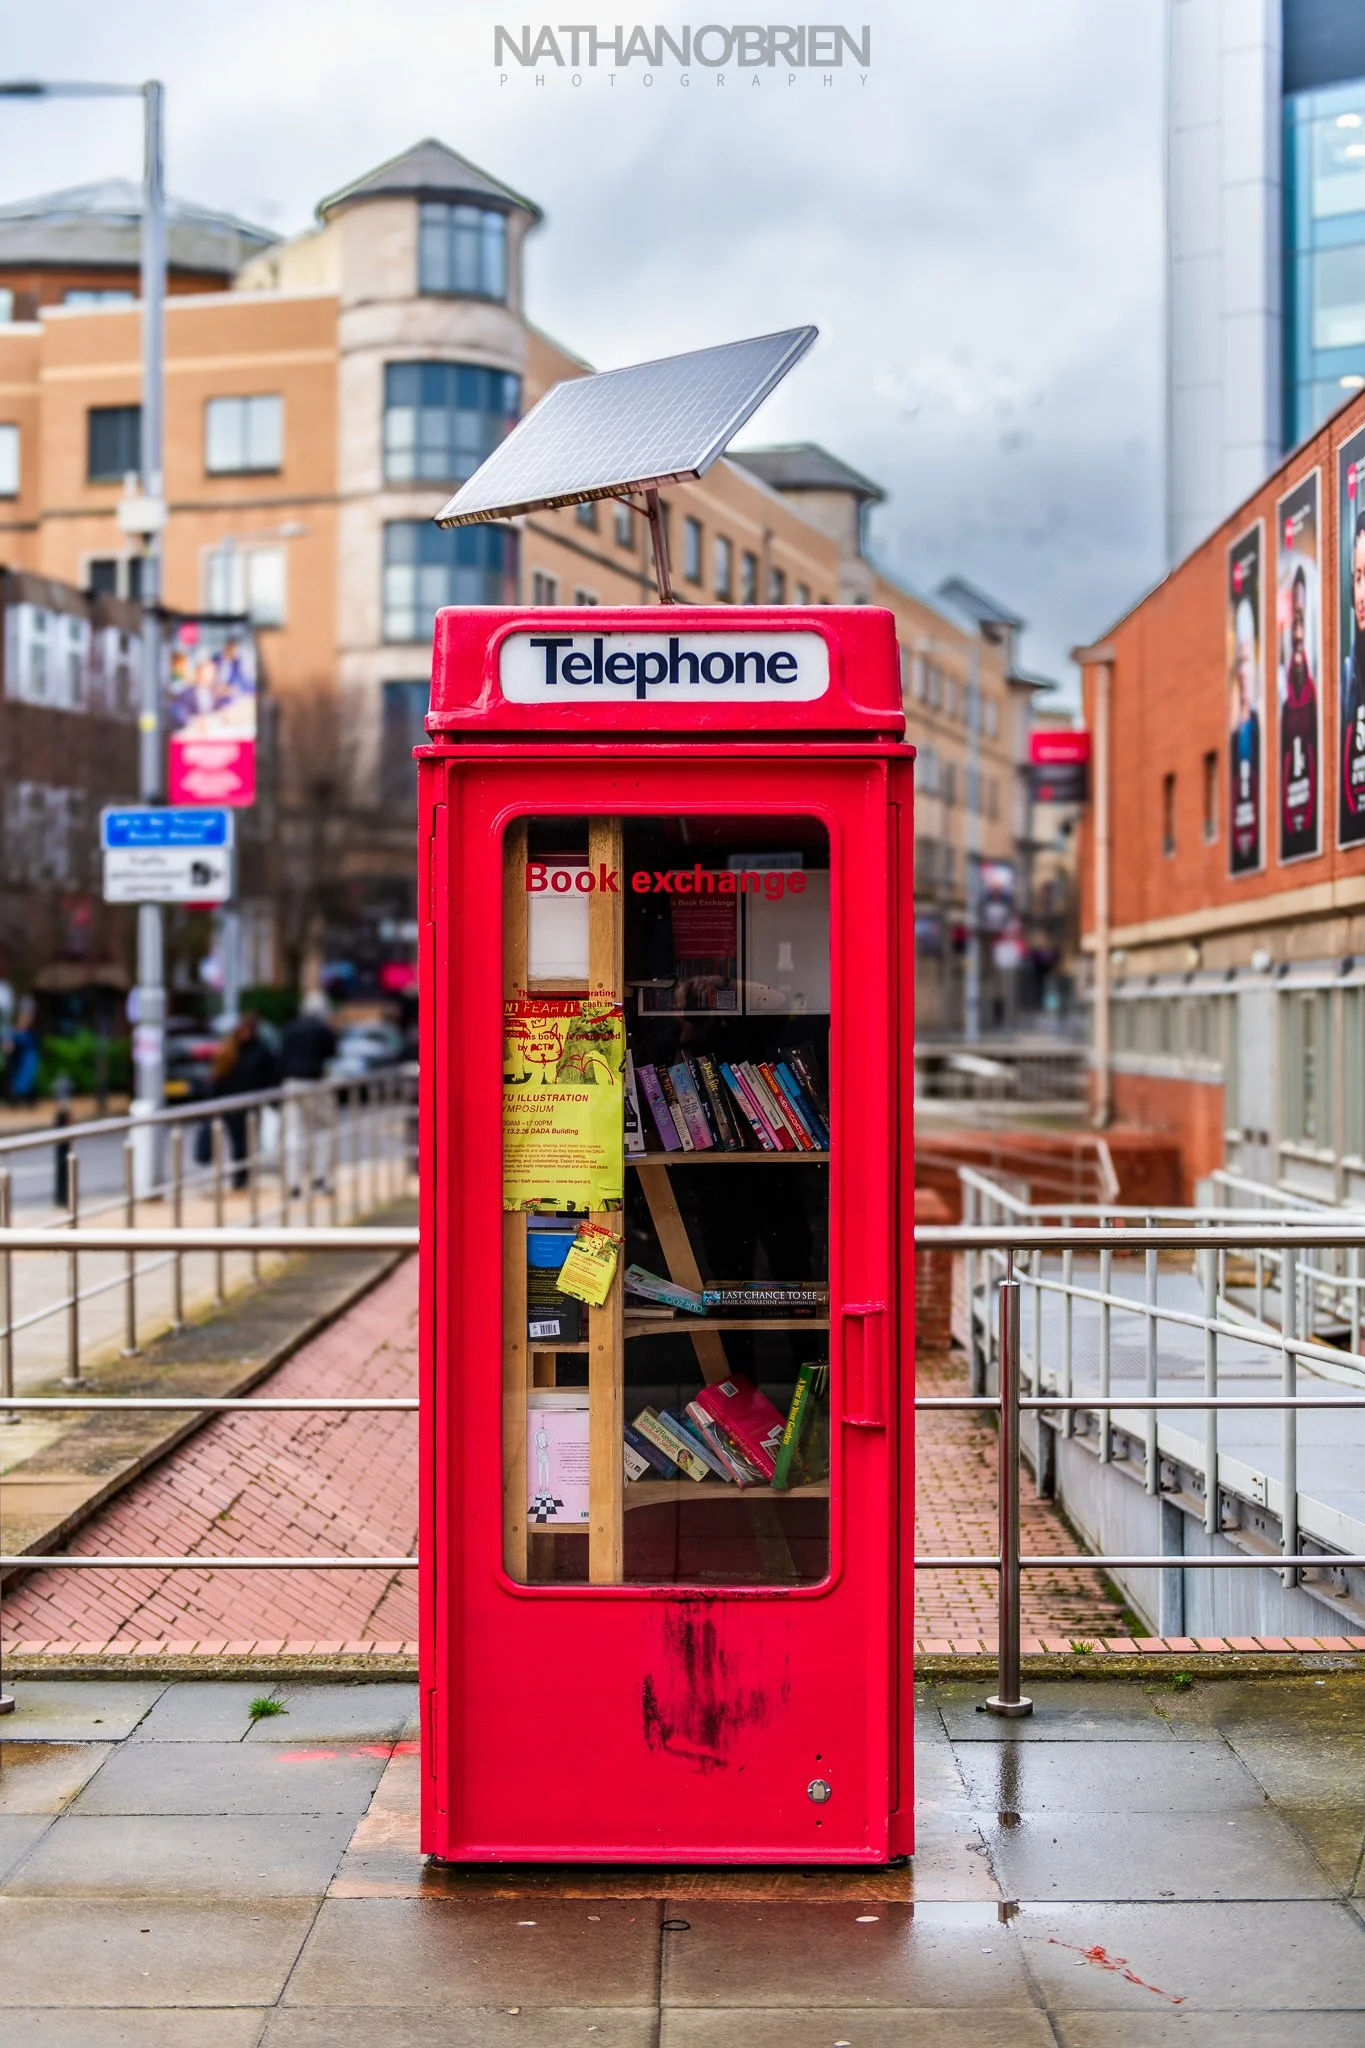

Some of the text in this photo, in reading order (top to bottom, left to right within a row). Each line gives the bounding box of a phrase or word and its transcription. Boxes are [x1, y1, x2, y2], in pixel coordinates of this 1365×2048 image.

[529, 637, 798, 700] Telephone
[525, 863, 808, 900] Book exchange
[582, 1001, 602, 1009] cash
[518, 1043, 528, 1052] by
[517, 1093, 589, 1102] ILLUSTRATION
[551, 1128, 579, 1136] Building
[722, 1290, 817, 1300] LAST CHANCE TO SEE
[664, 1294, 704, 1313] OUR ZOO
[795, 1383, 805, 1398] Year
[793, 1398, 802, 1406] in
[788, 1406, 800, 1421] Your
[641, 1415, 657, 1429] Sheila
[637, 1420, 662, 1443] Suddenly
[659, 1439, 677, 1455] Single
[782, 1421, 796, 1446] Garden
